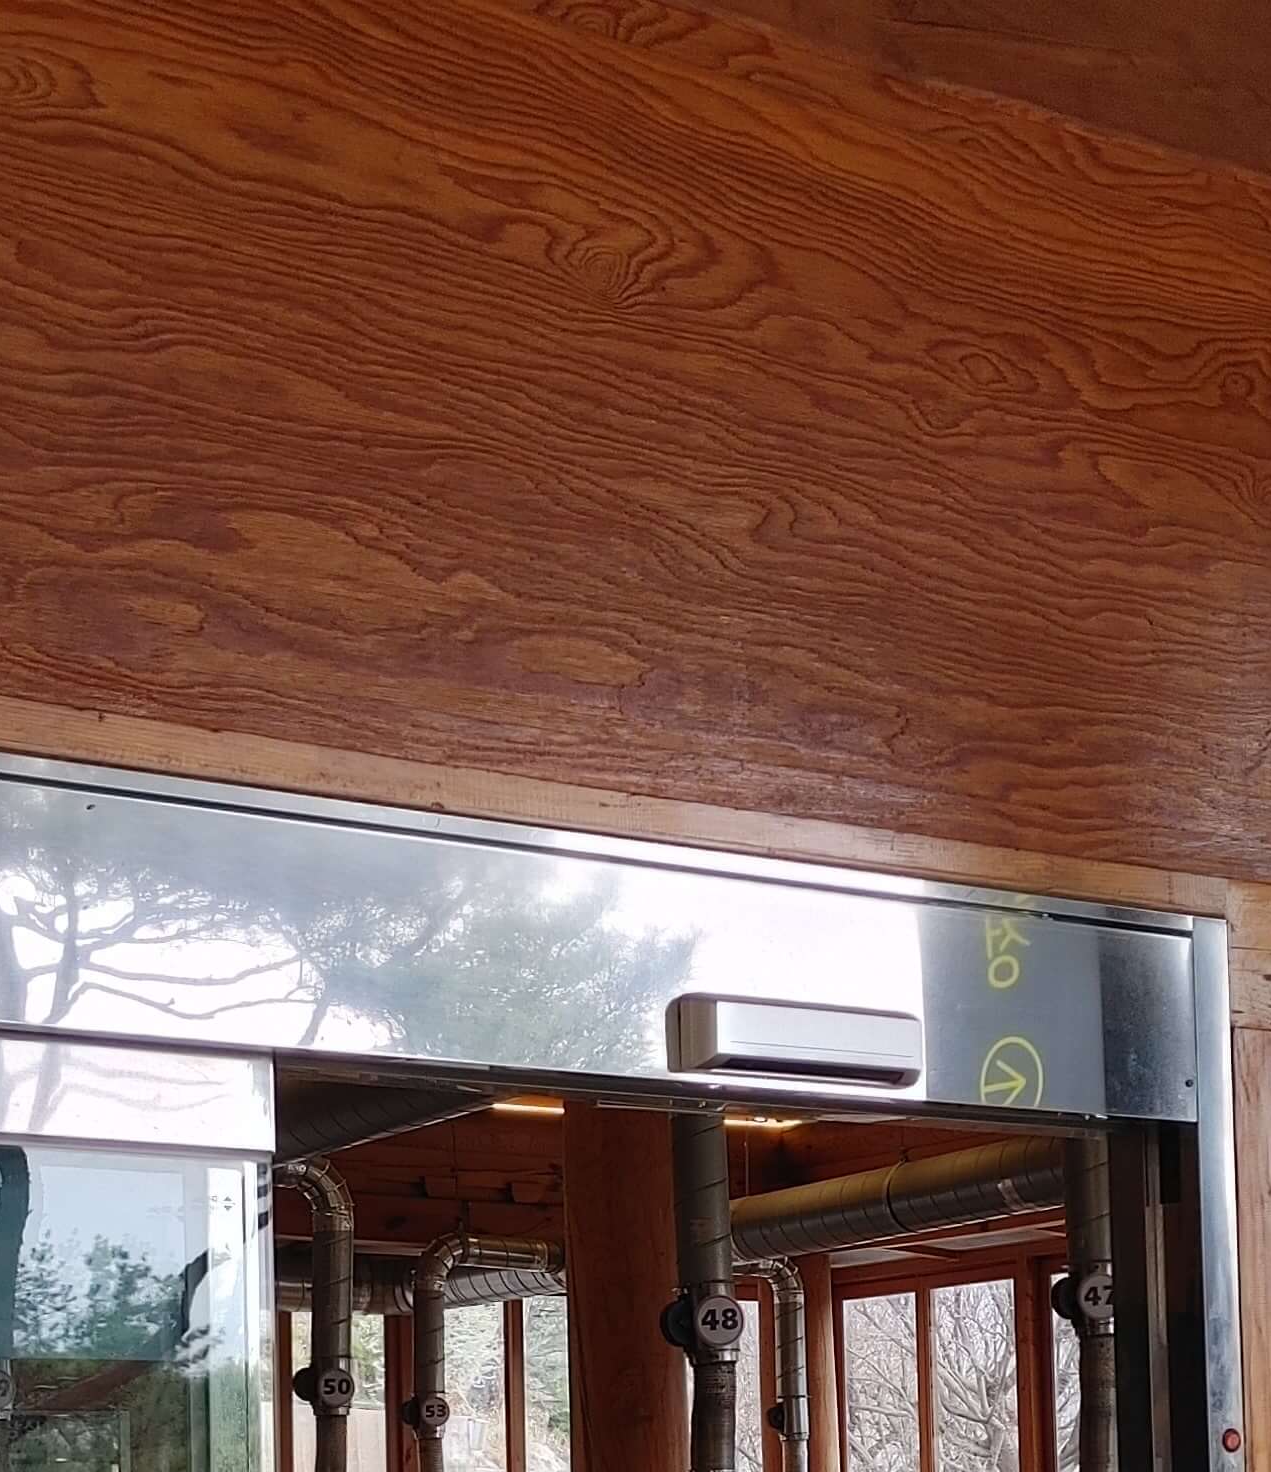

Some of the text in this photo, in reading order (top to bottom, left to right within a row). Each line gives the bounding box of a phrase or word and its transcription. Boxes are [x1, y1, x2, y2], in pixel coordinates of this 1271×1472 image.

[701, 1308, 739, 1331] 48
[323, 1379, 351, 1395] 50
[425, 1404, 447, 1418] 53
